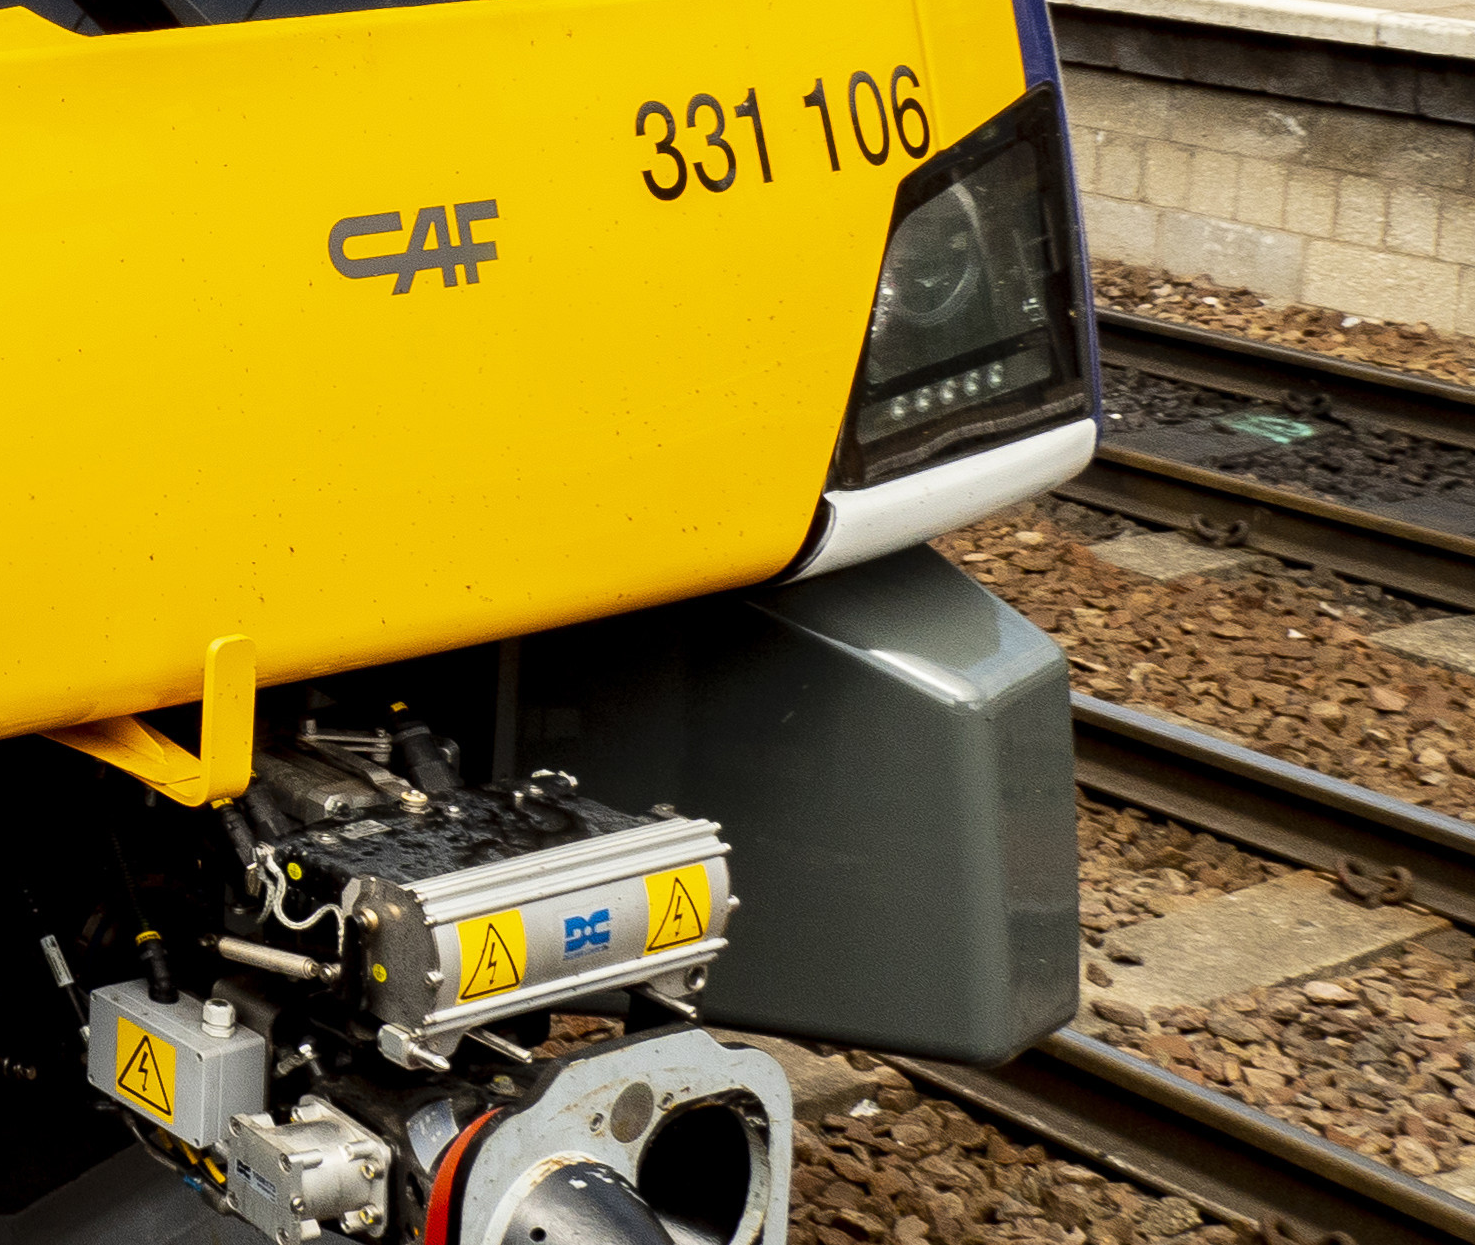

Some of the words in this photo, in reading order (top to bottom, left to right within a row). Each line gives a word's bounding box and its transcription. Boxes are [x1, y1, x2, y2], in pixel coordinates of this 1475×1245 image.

[635, 87, 773, 202] 331
[802, 64, 930, 173] 106
[328, 199, 499, 296] CAF
